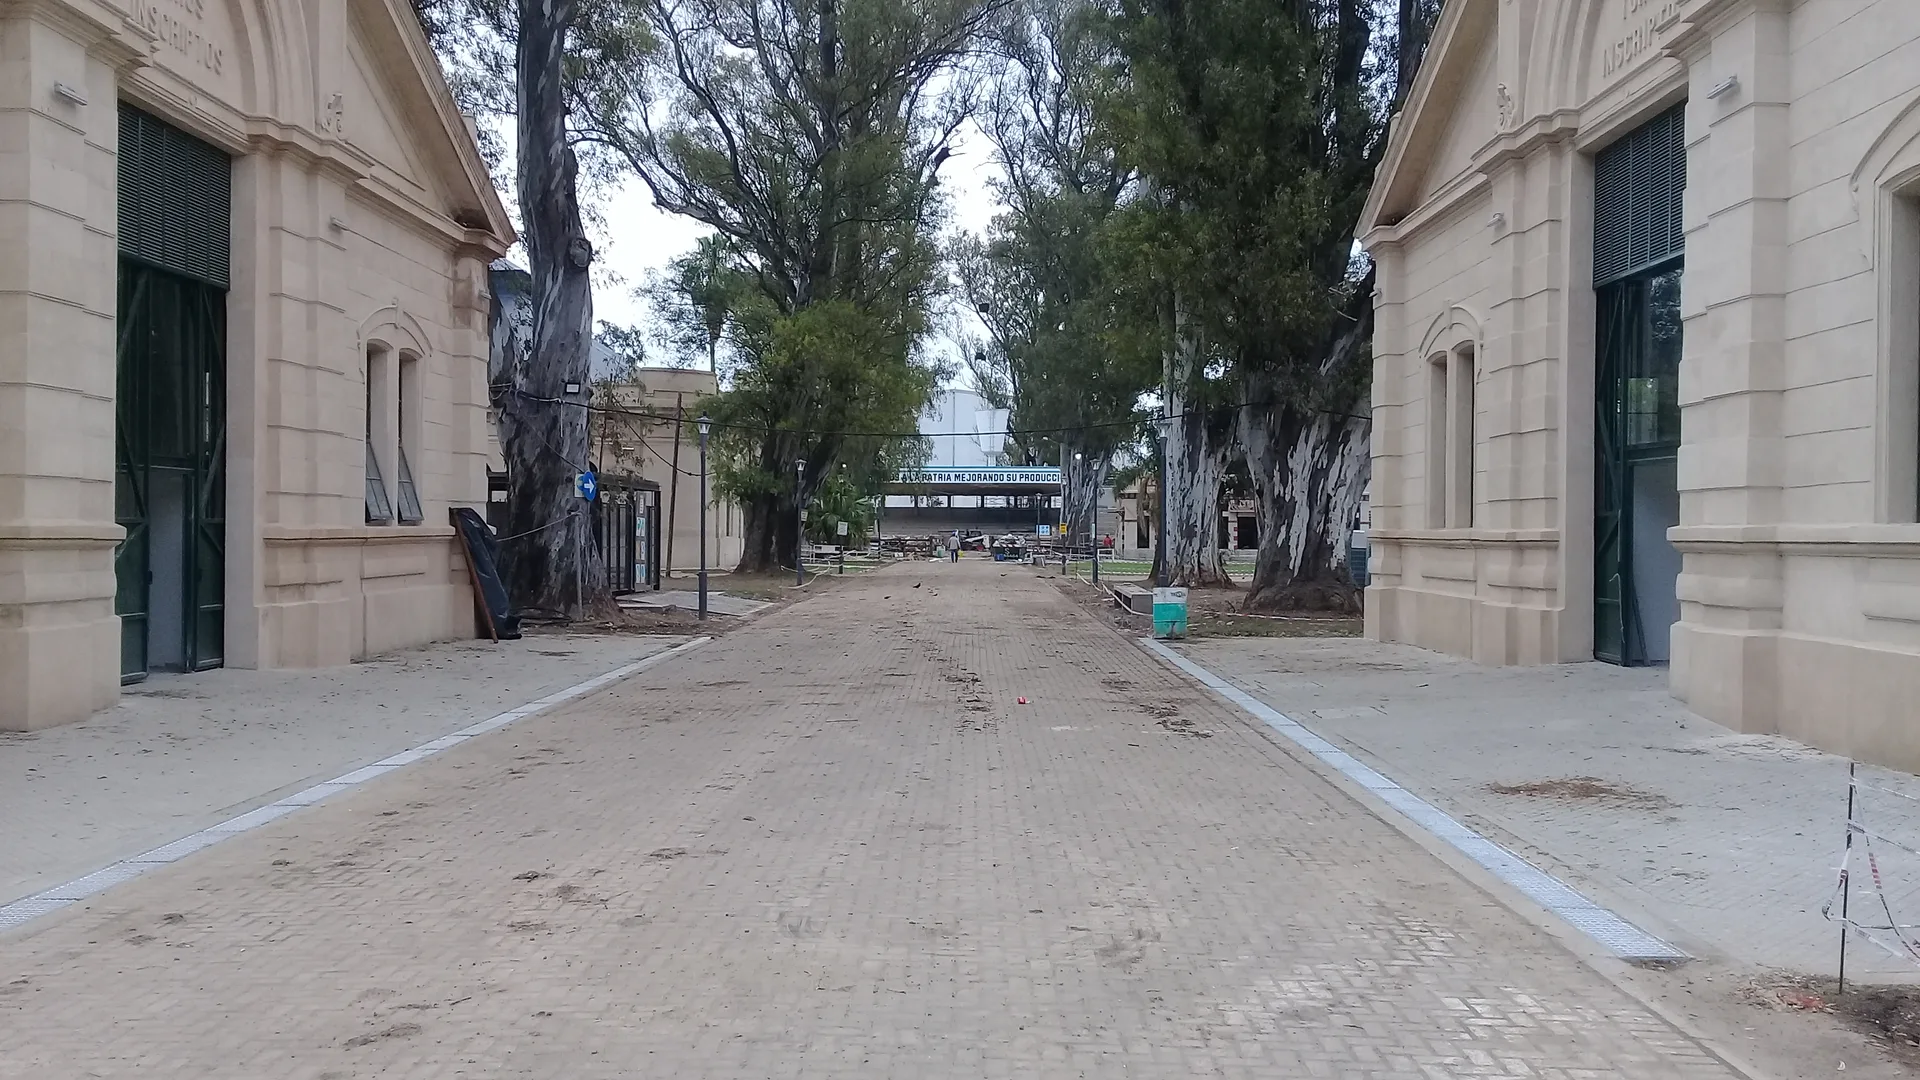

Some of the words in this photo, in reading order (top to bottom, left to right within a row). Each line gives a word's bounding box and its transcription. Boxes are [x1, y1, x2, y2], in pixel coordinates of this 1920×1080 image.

[922, 473, 952, 482] PATRIA
[954, 473, 1005, 482] MEJORANDO
[1006, 473, 1017, 482] SU
[1020, 473, 1060, 482] PRODUCCI
